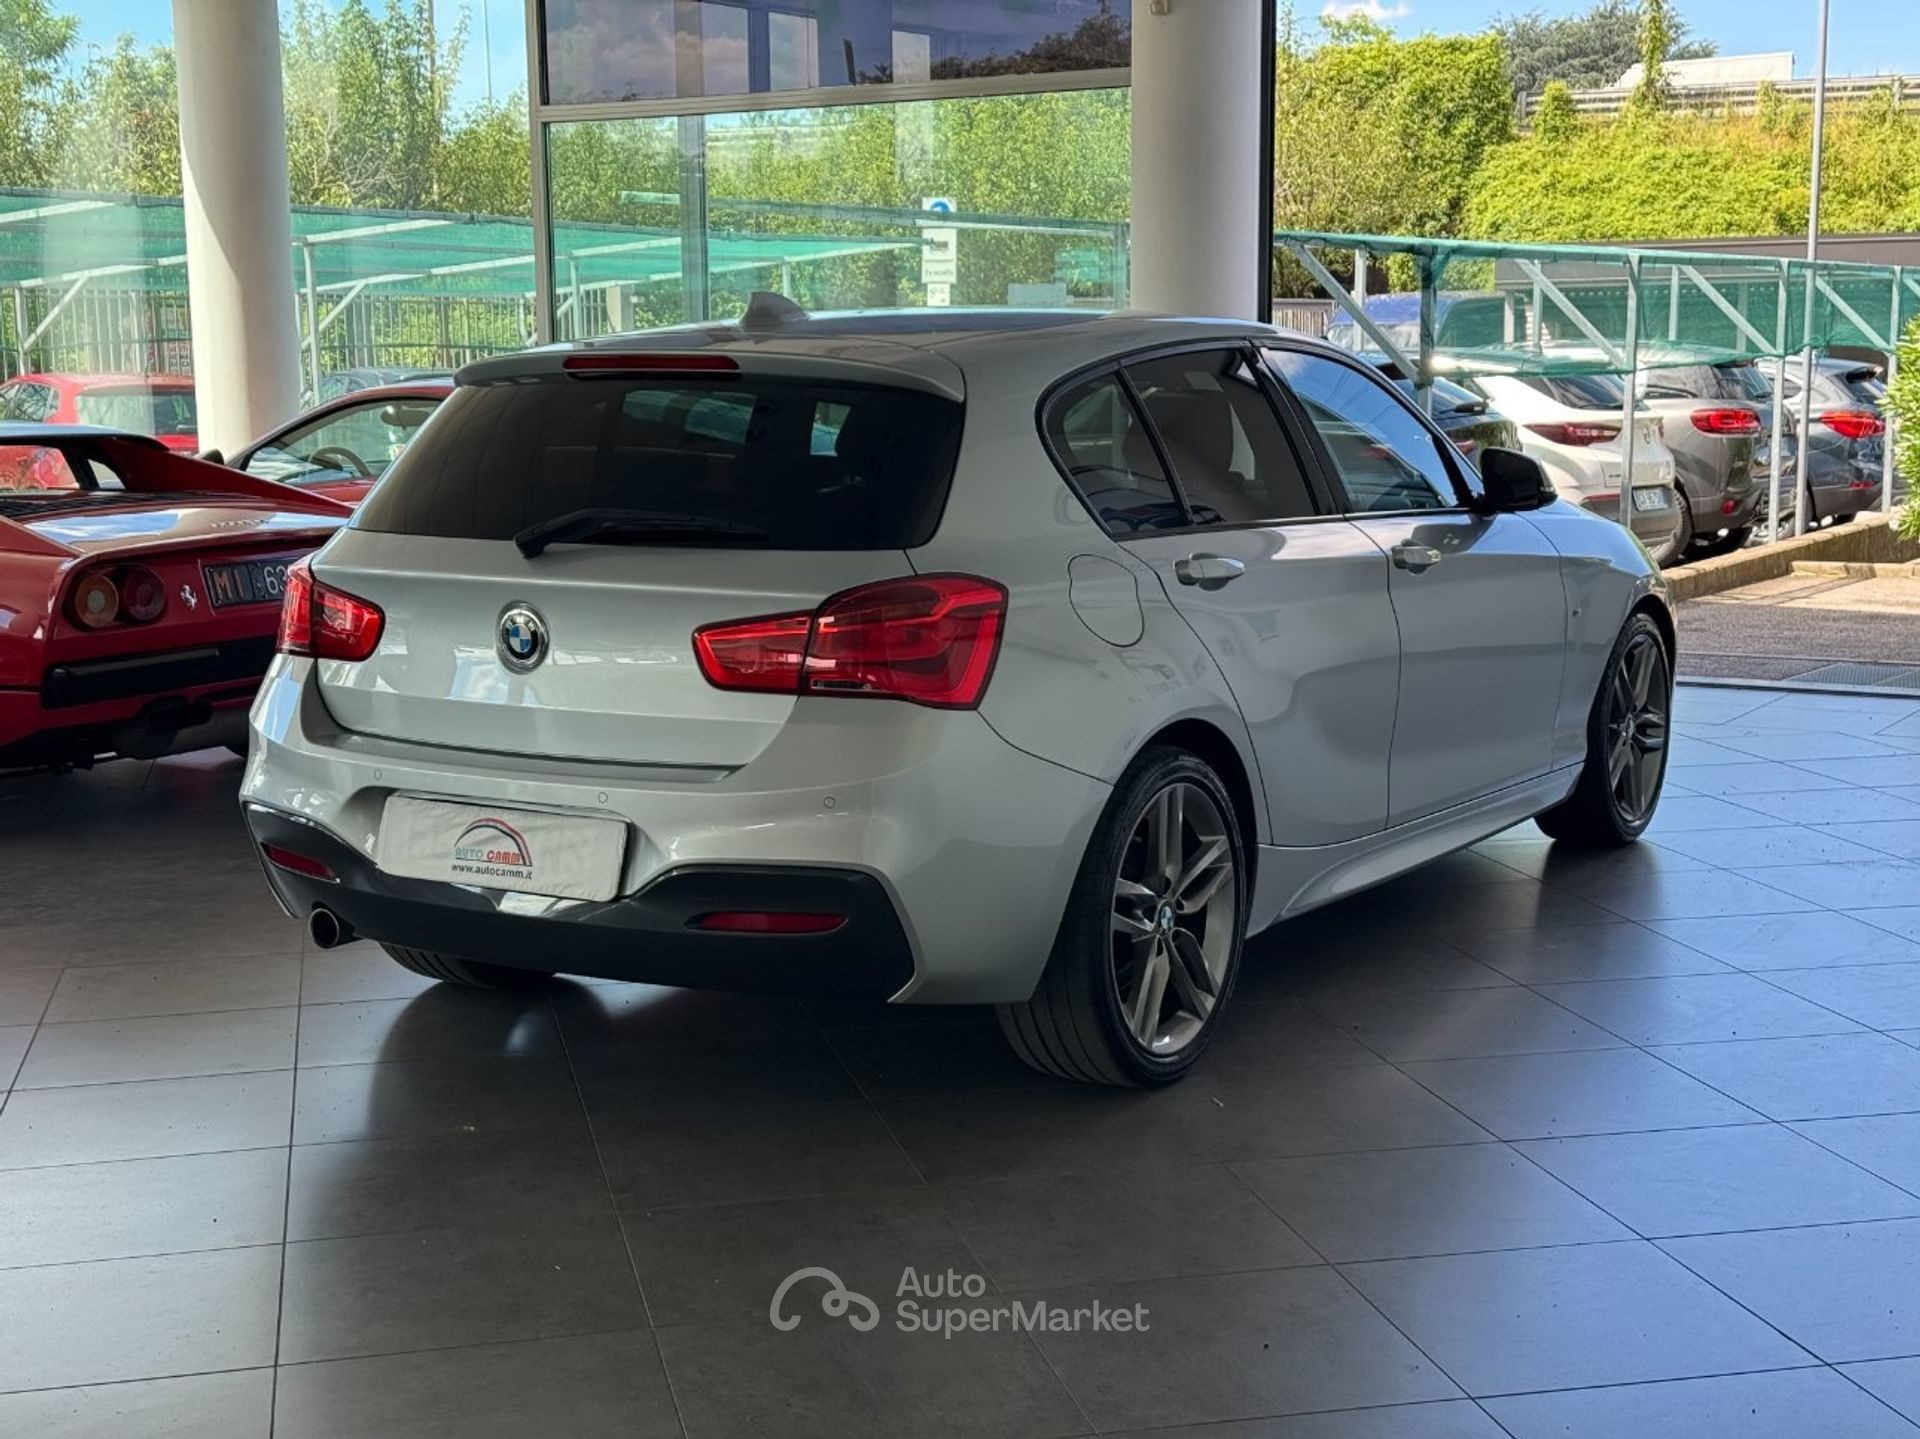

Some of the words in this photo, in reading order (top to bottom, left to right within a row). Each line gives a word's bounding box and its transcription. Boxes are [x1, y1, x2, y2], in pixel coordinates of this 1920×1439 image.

[213, 570, 245, 600] MI
[455, 847, 483, 859] AUTO
[452, 864, 533, 880] www.autocamm.it
